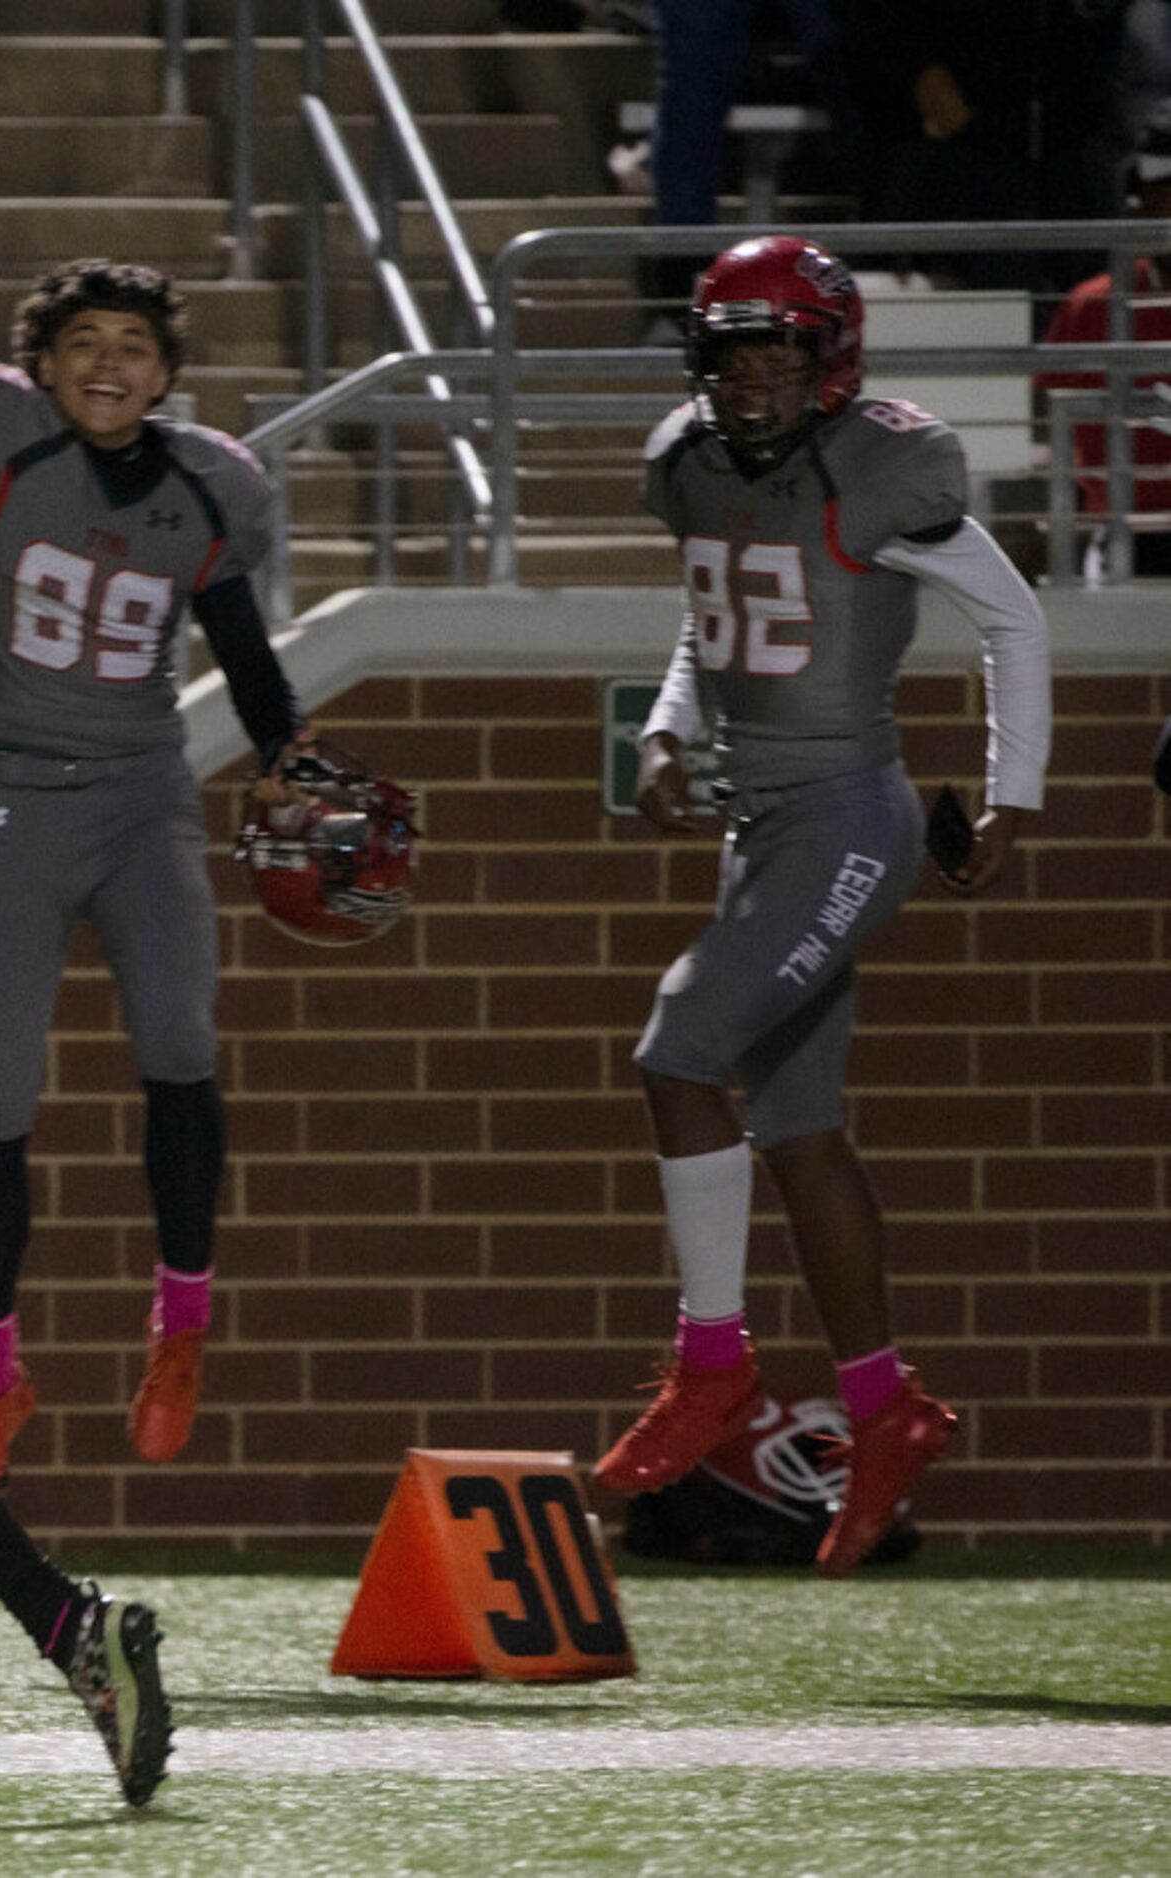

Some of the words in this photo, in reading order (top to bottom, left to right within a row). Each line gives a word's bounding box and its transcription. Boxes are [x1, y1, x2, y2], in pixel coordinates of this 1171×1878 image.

[10, 540, 173, 681] 89
[684, 537, 814, 677] 82
[775, 932, 832, 986] HILL
[816, 851, 887, 937] CEDAR
[445, 1474, 629, 1657] 30
